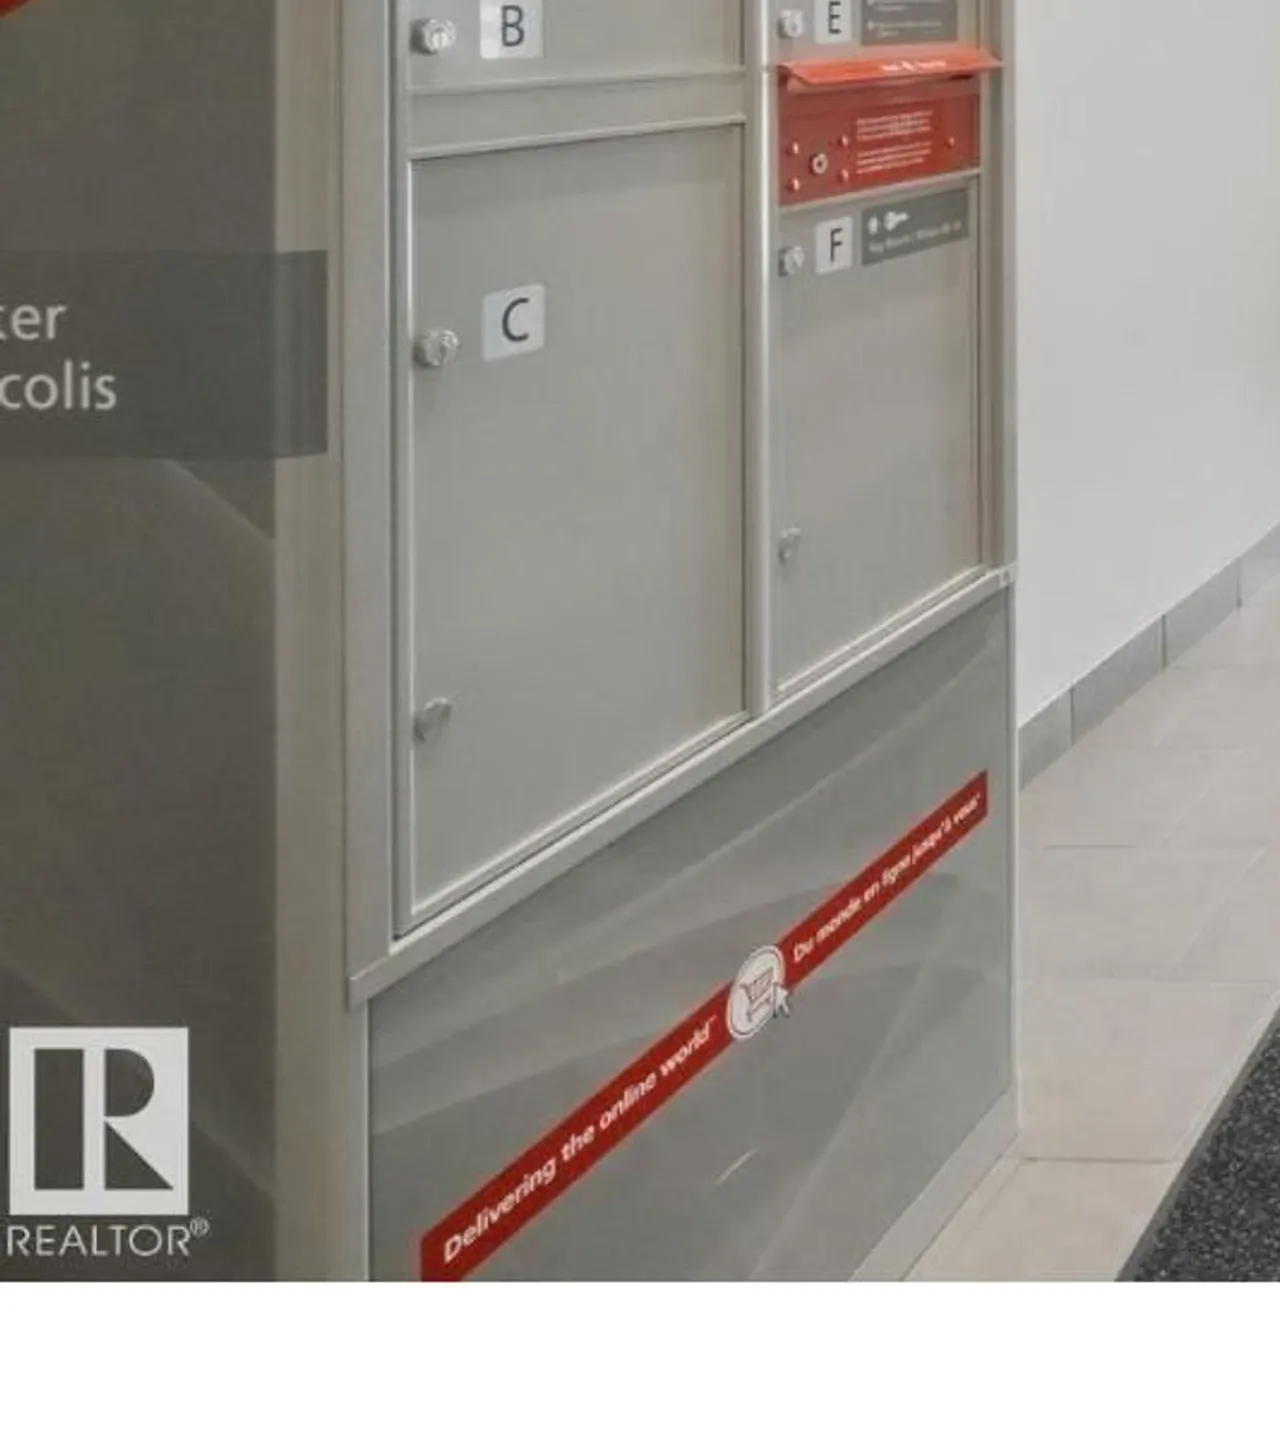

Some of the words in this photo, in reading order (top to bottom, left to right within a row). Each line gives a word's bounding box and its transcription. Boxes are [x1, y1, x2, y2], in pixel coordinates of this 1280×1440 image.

[501, 4, 525, 48] B
[828, 0, 842, 35] E
[829, 227, 843, 265] F
[0, 305, 68, 340] er
[501, 296, 531, 343] C
[0, 358, 117, 411] colis
[793, 937, 815, 964] Du
[815, 897, 862, 945] monde
[863, 881, 881, 903] en
[443, 1157, 557, 1264] Delivering
[560, 1124, 596, 1163] the
[599, 1071, 657, 1131] online
